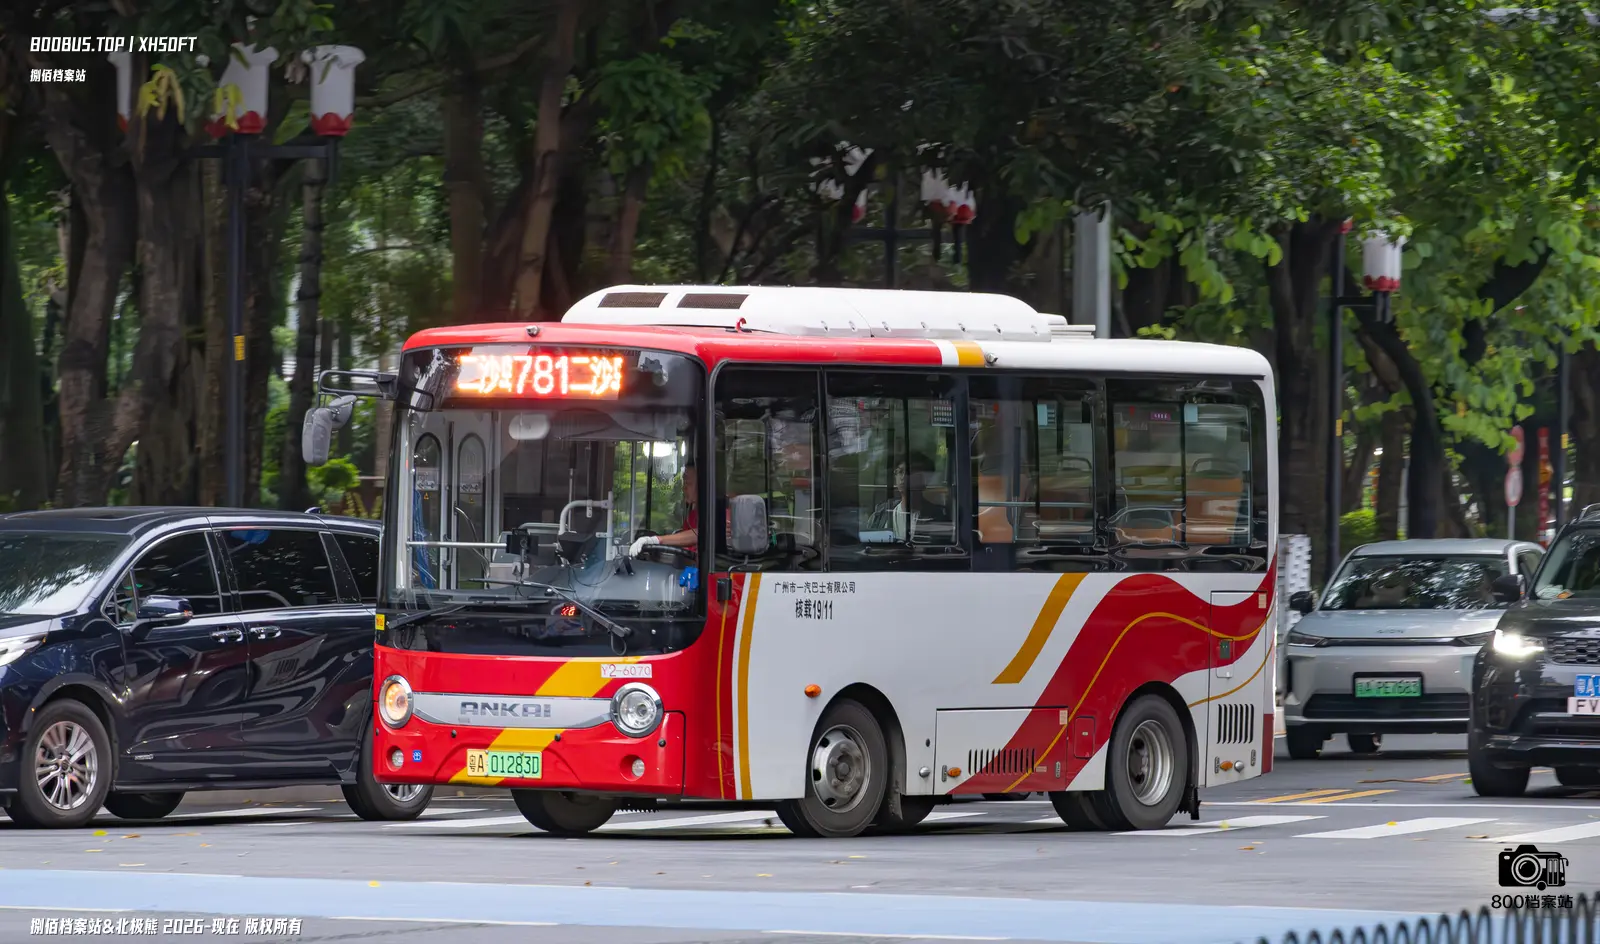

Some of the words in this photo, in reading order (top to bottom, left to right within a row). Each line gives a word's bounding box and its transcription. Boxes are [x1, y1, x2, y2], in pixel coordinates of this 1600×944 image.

[774, 581, 856, 594] 广州市一汽巴士有限公司
[601, 663, 651, 678] Y2-6070
[460, 702, 551, 717] ANKAI
